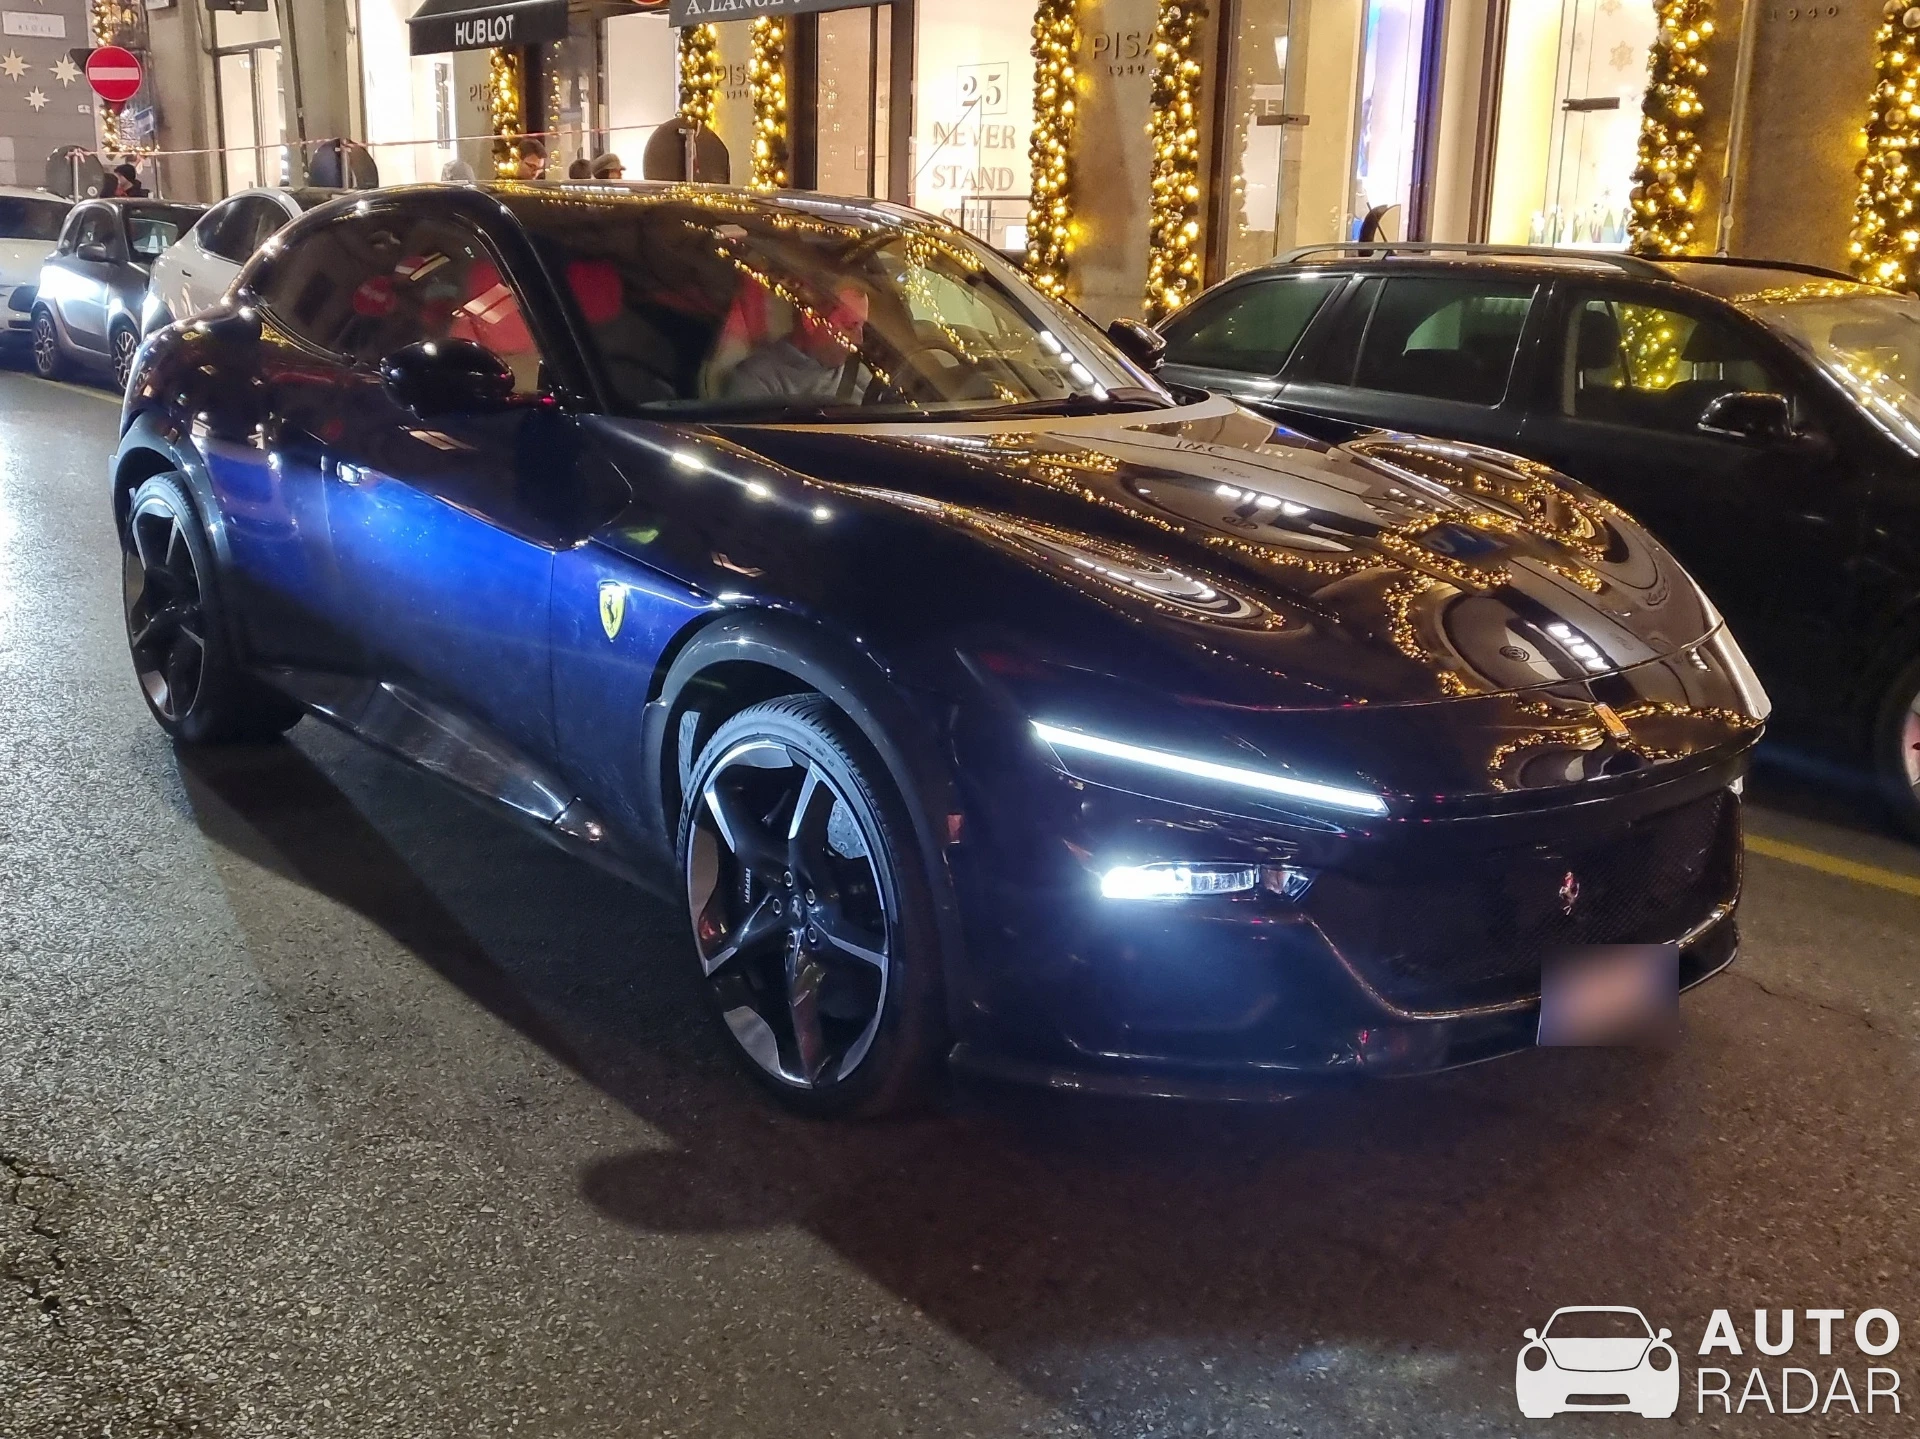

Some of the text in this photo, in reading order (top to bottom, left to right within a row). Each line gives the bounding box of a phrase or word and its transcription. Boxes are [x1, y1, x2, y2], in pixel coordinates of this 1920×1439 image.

[1767, 6, 1838, 21] 1940
[455, 14, 514, 46] HUBLOT
[714, 64, 747, 87] PIS
[469, 83, 491, 101] PIS
[962, 74, 1002, 107] 25
[932, 121, 1016, 150] NEVER
[931, 164, 1015, 192] STAND
